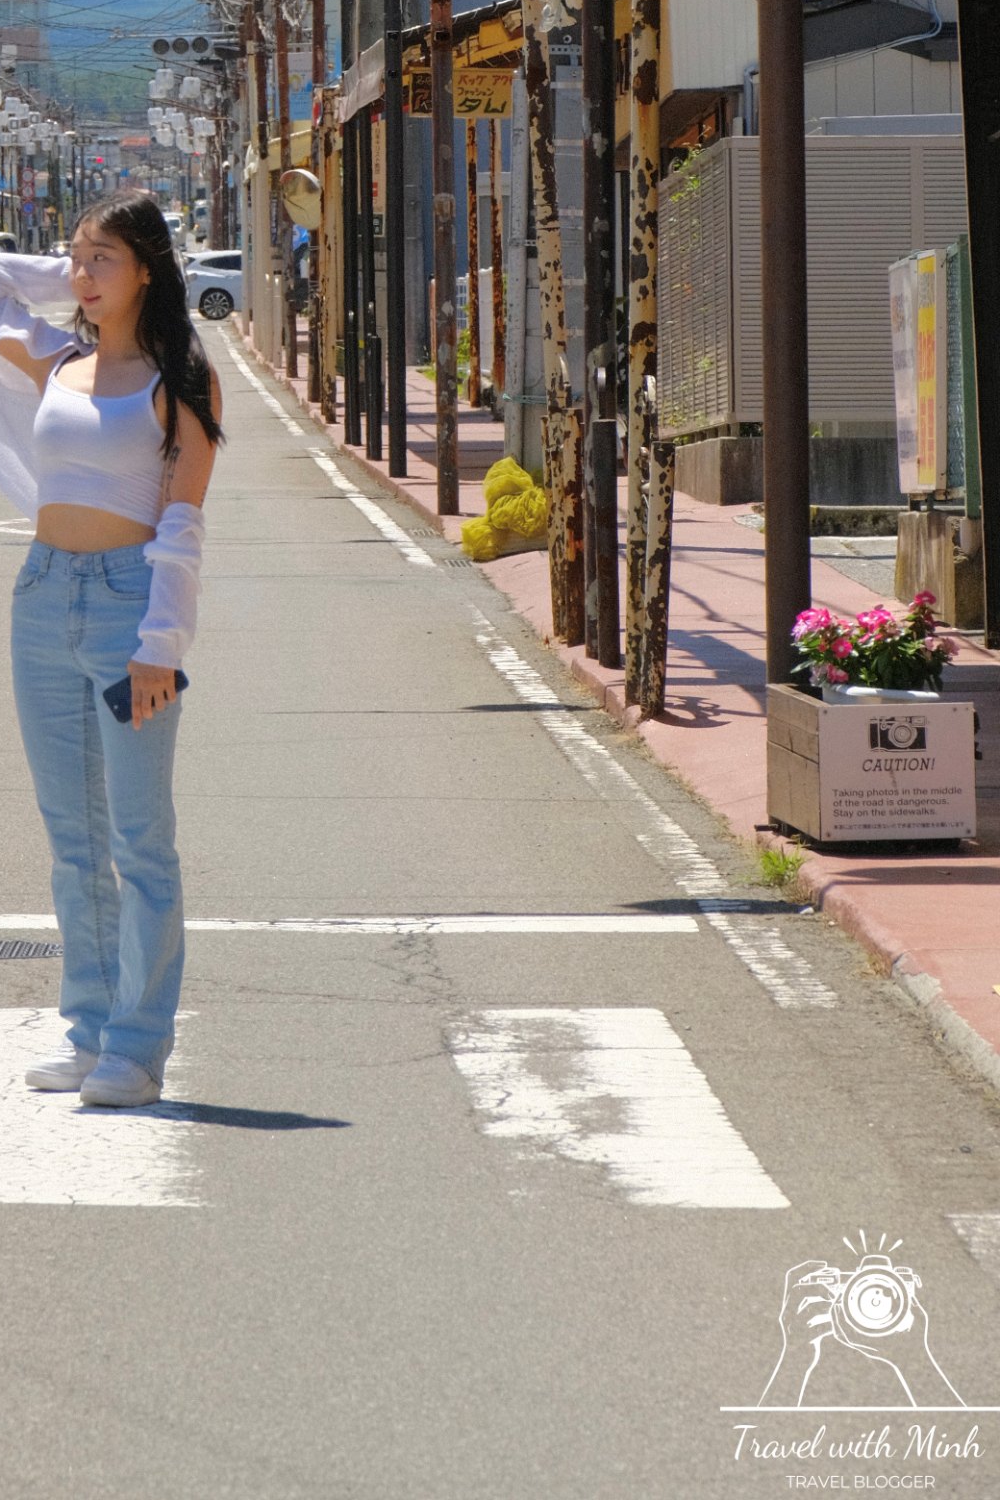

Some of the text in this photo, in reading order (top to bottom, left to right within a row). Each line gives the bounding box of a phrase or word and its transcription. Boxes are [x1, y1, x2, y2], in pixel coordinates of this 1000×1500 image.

[862, 758, 936, 772] CAUTION!
[833, 787, 963, 799] Taking photos in the middle
[833, 798, 950, 808] of the road is dangerous.
[833, 809, 854, 818] Stay
[871, 809, 886, 817] the
[889, 808, 936, 817] sidewalks.
